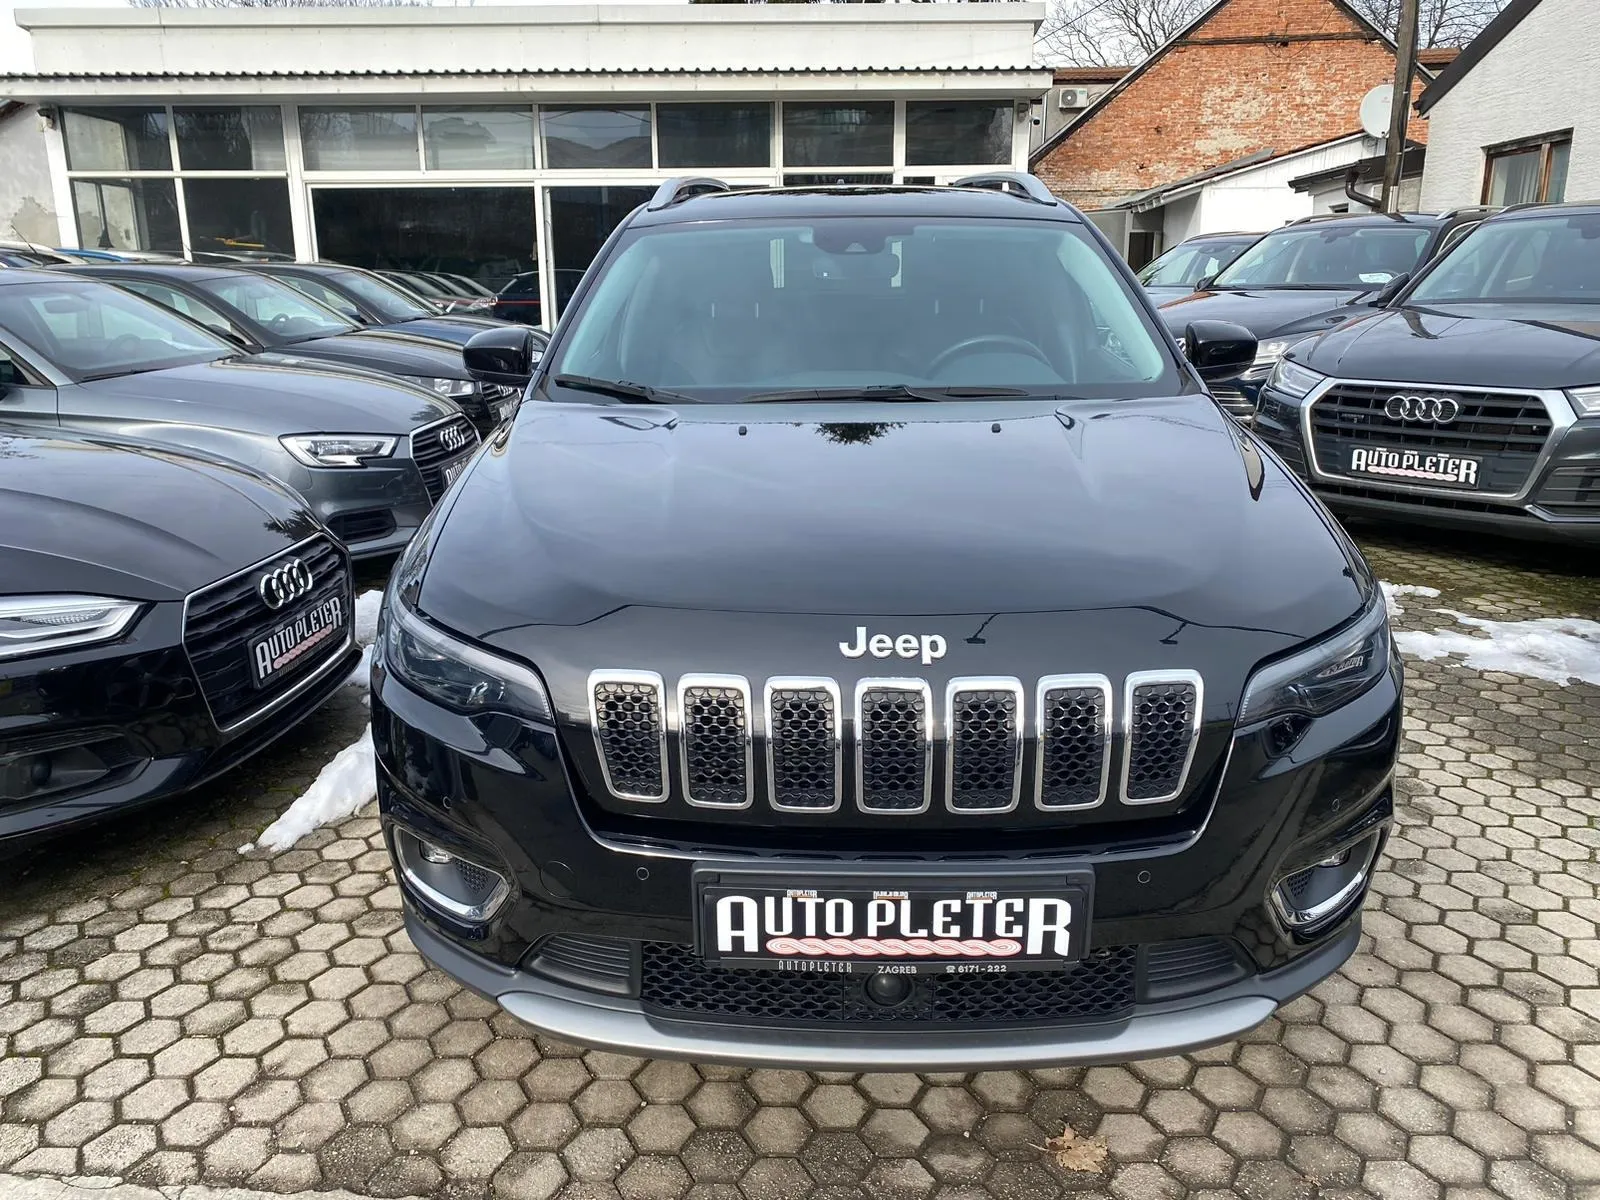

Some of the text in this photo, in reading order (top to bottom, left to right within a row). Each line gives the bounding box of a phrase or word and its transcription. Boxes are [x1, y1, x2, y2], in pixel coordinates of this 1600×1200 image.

[1351, 449, 1478, 484] AUTO PLETER
[255, 626, 295, 679] AUTO
[295, 597, 342, 643] PLETER
[839, 626, 947, 665] Jeep
[716, 895, 1072, 957] AUTO PLETER
[778, 960, 852, 973] AUTOPLETER
[878, 965, 918, 974] ZAGREB
